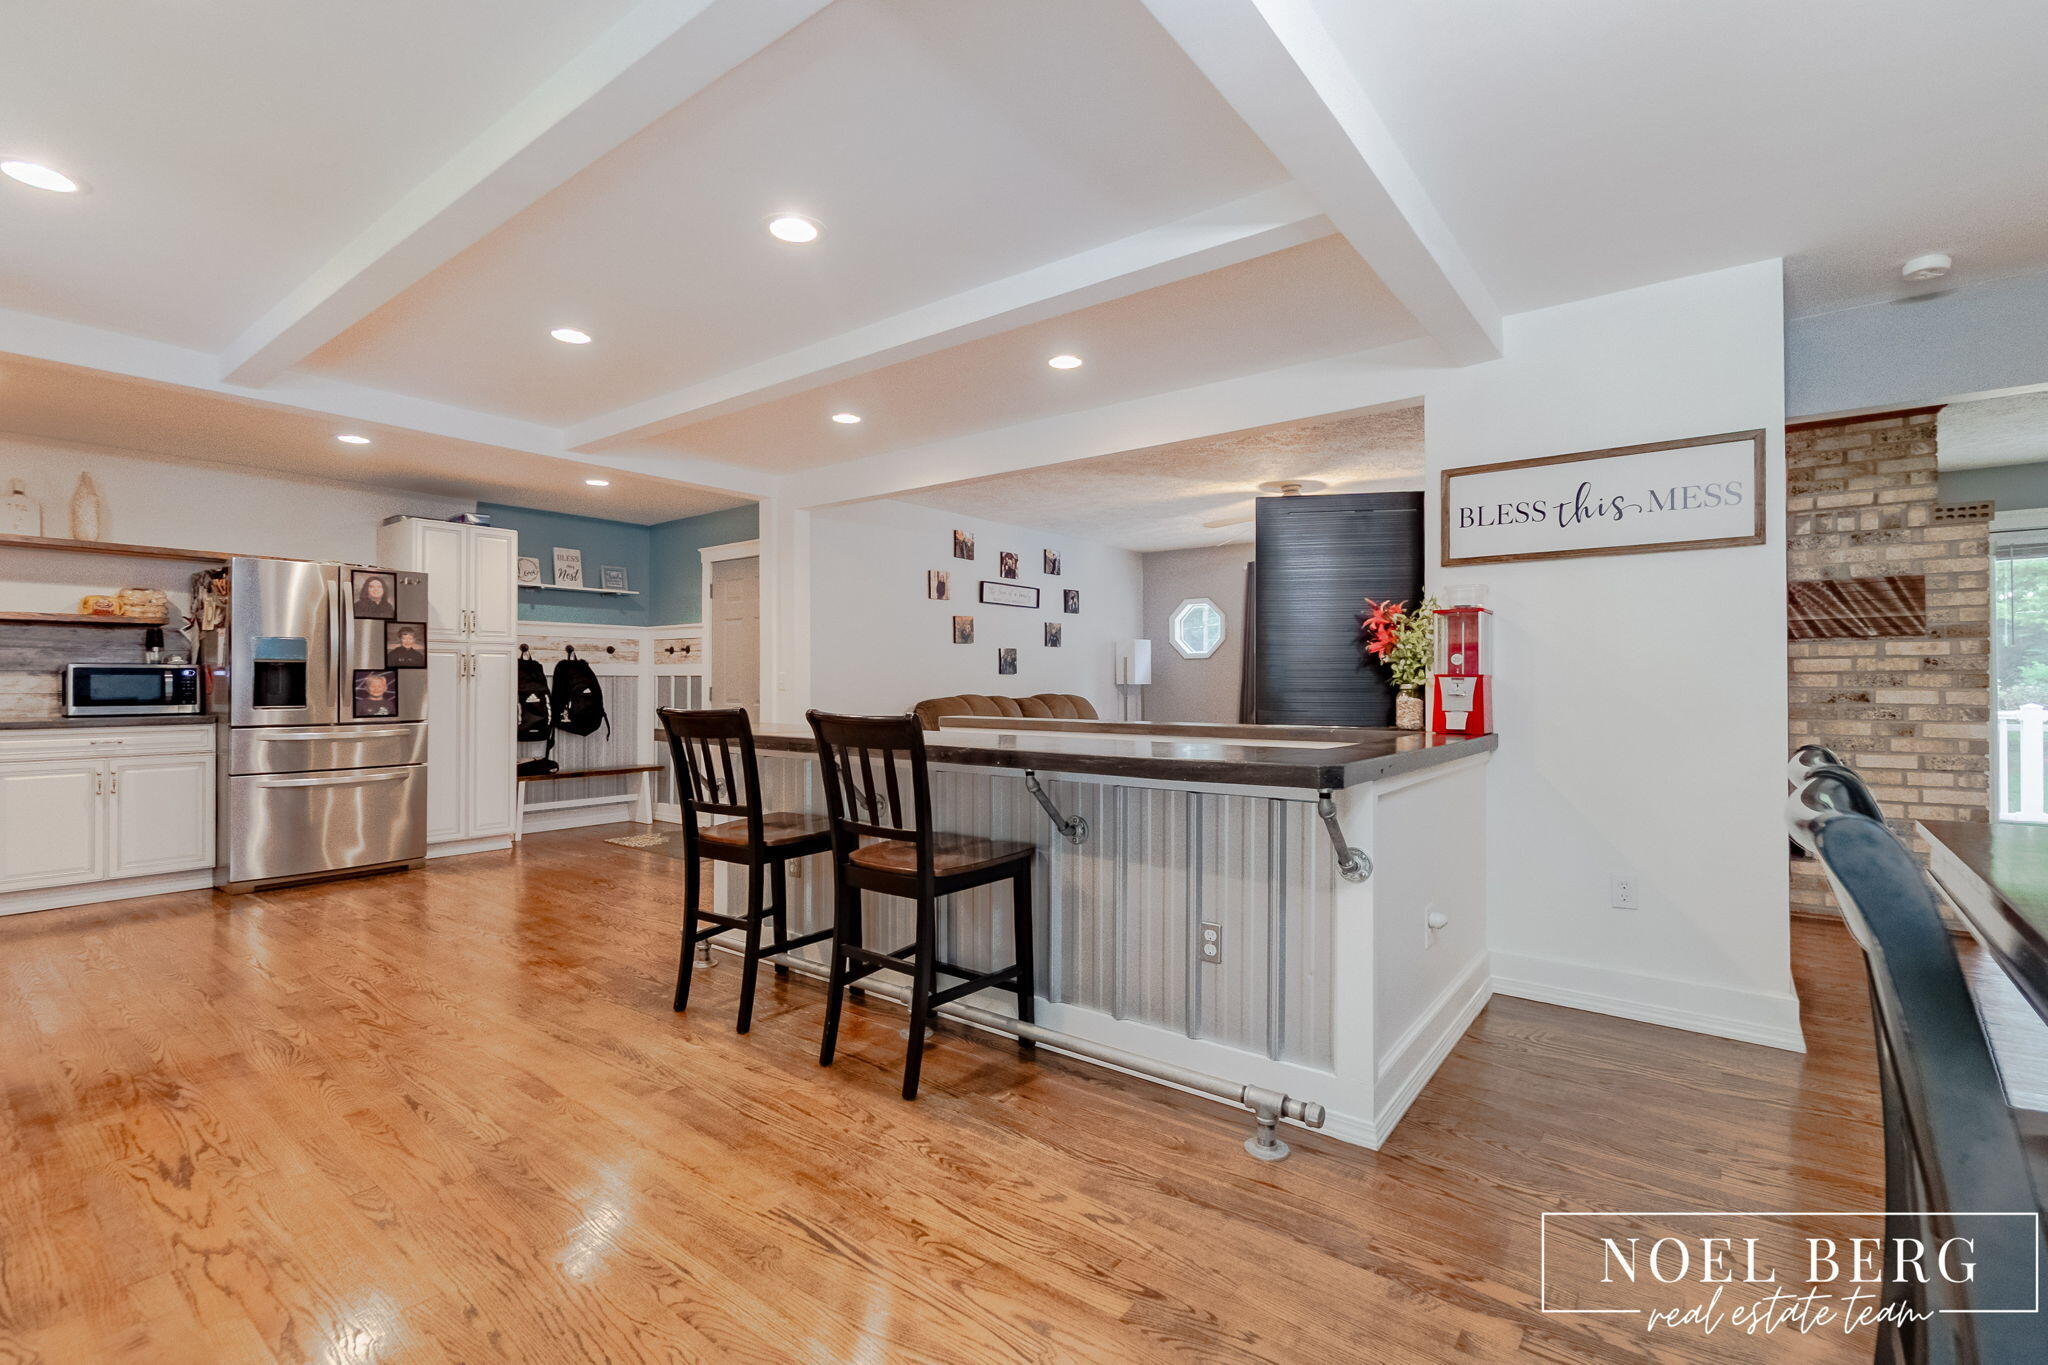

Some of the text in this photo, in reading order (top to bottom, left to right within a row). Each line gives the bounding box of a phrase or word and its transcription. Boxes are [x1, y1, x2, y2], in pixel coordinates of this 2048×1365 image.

[1459, 481, 1743, 529] BLESS this MESS
[557, 568, 580, 582] Nest
